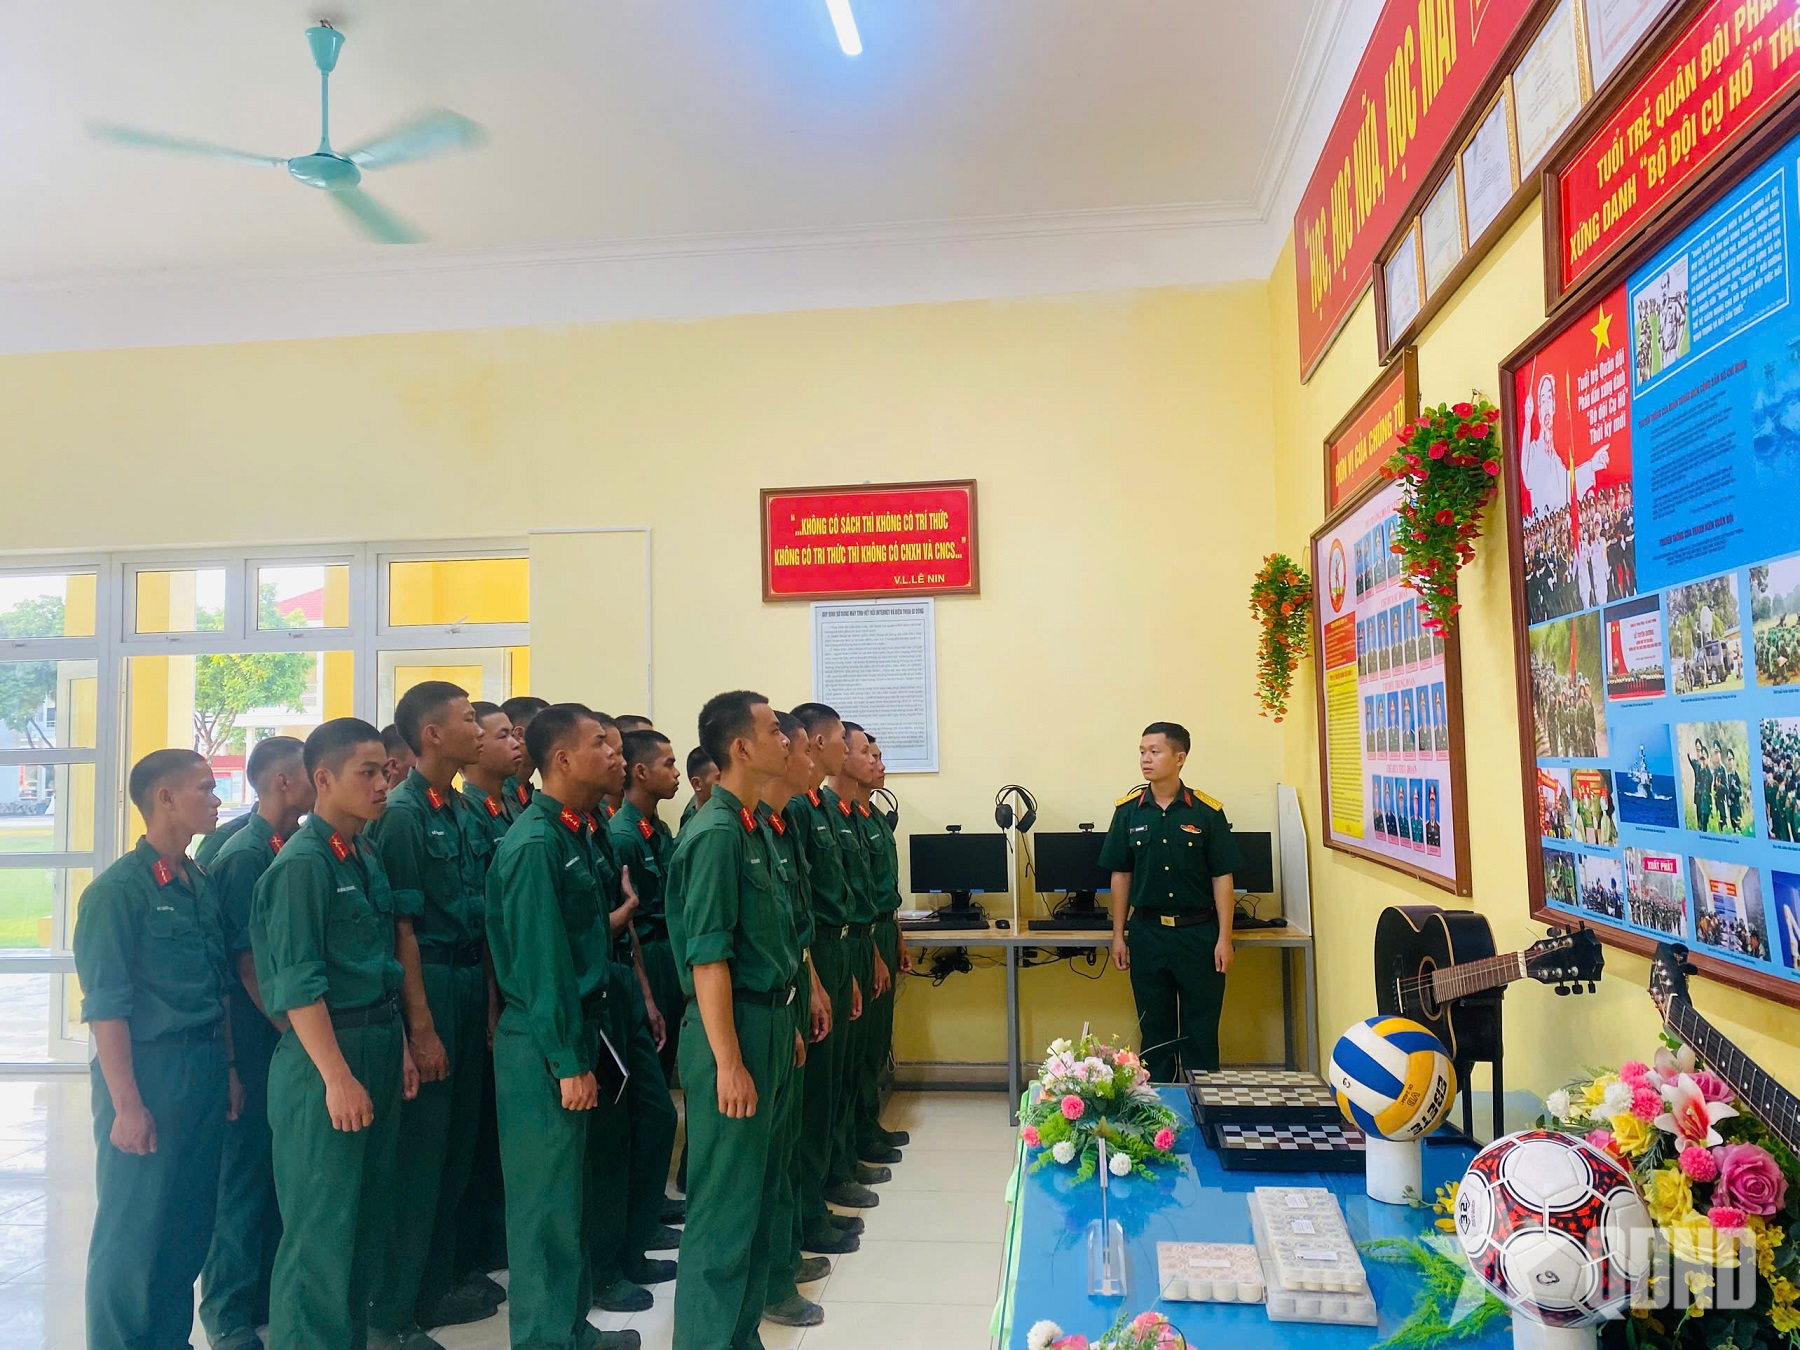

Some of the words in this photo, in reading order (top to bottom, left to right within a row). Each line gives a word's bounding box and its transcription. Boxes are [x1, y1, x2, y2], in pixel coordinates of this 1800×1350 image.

[1597, 128, 1625, 189] TUỔI
[1627, 97, 1652, 157] TRẺ
[1655, 57, 1696, 128] QUÂN
[1701, 22, 1730, 81] ĐỘI
[1331, 156, 1353, 282] HỌC
[1353, 89, 1385, 235] NỮA,
[1384, 25, 1418, 182] HỌC
[1570, 211, 1600, 265] XỨNG
[1602, 173, 1637, 232] DANH
[1640, 139, 1667, 189] “BỘ
[1671, 113, 1697, 167] ĐỘI
[1702, 86, 1724, 136] CỤ
[1729, 36, 1762, 111] HỒ”
[1577, 368, 1589, 392] Tuổi
[1590, 363, 1599, 385] trẻ
[1600, 356, 1615, 380] Quân
[1615, 347, 1625, 368] đội
[1613, 369, 1625, 390] danh
[1598, 400, 1608, 422] đội
[1613, 410, 1626, 432] mới
[1335, 456, 1348, 487] ĐƠN
[1348, 449, 1354, 479] VỊ
[1354, 432, 1368, 470] CỦA
[1368, 410, 1392, 455] CHÚNG
[828, 513, 839, 535] CÓ
[840, 512, 861, 534] SÁCH
[862, 511, 874, 533] THÌ
[875, 511, 902, 532] KHÔNG
[903, 510, 913, 531] CÓ
[915, 509, 927, 531] TRÍ
[928, 508, 949, 530] THỨC
[774, 545, 800, 566] KHÔNG
[801, 544, 812, 566] CÓ
[827, 543, 846, 564] THỨC
[847, 542, 860, 564] THÌ
[861, 541, 887, 563] KHÔNG
[888, 540, 898, 562] CÓ
[900, 543, 922, 562] CNXH
[923, 539, 933, 561] VÀ
[894, 573, 924, 585] V.L.LÊ
[927, 573, 945, 584] NIN
